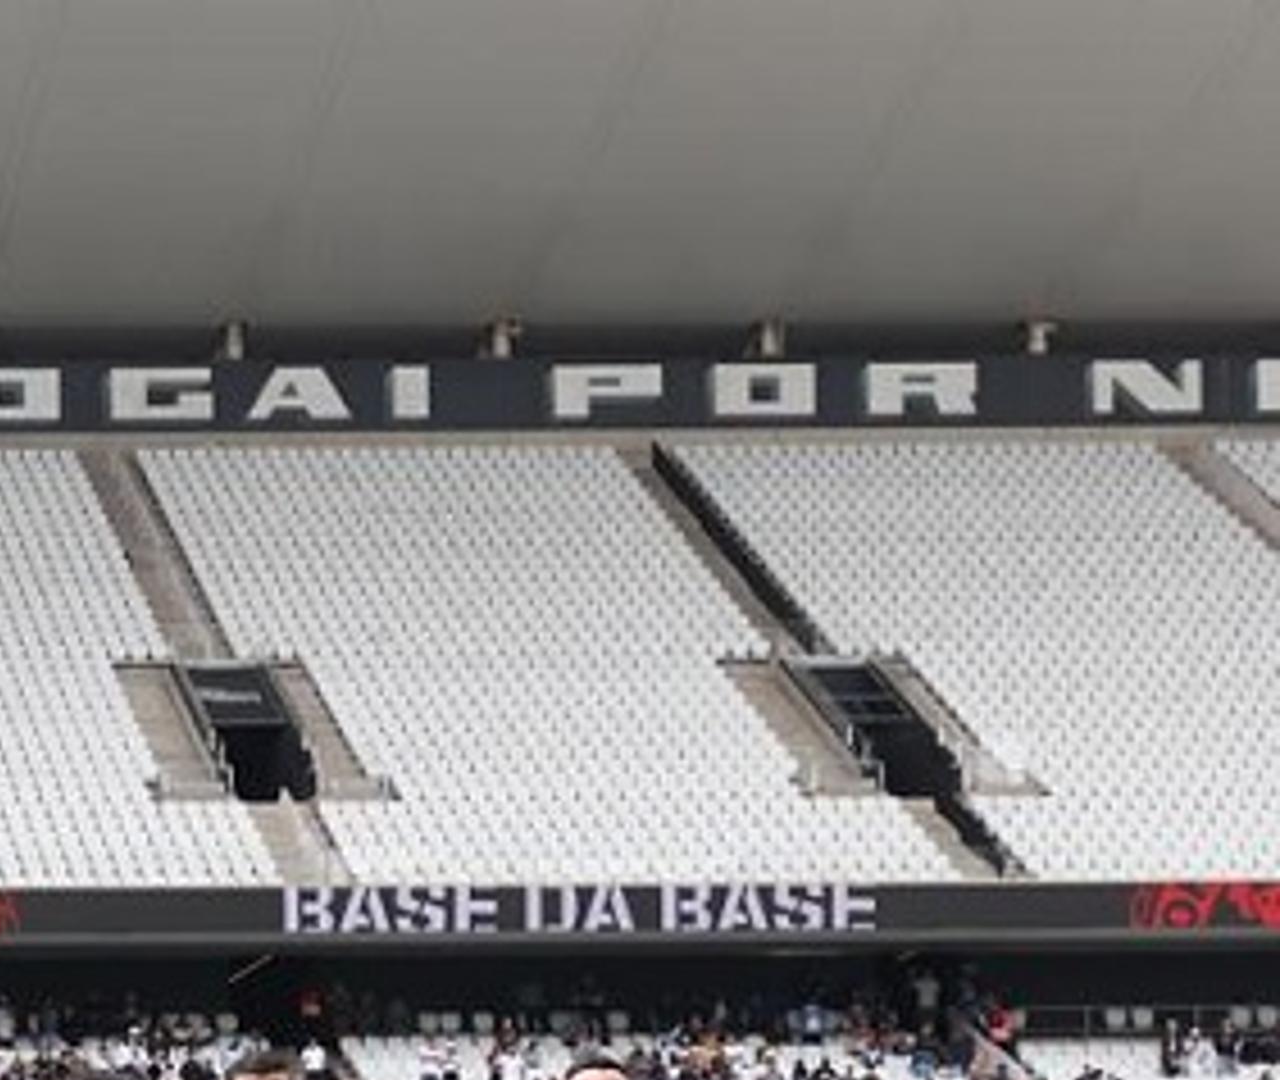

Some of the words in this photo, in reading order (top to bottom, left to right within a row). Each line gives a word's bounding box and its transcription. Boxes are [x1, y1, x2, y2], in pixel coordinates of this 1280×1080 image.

[551, 363, 977, 417] POR
[1090, 360, 1280, 413] N
[282, 885, 497, 932] BASE
[525, 885, 634, 932] DA
[659, 885, 876, 932] BASE
